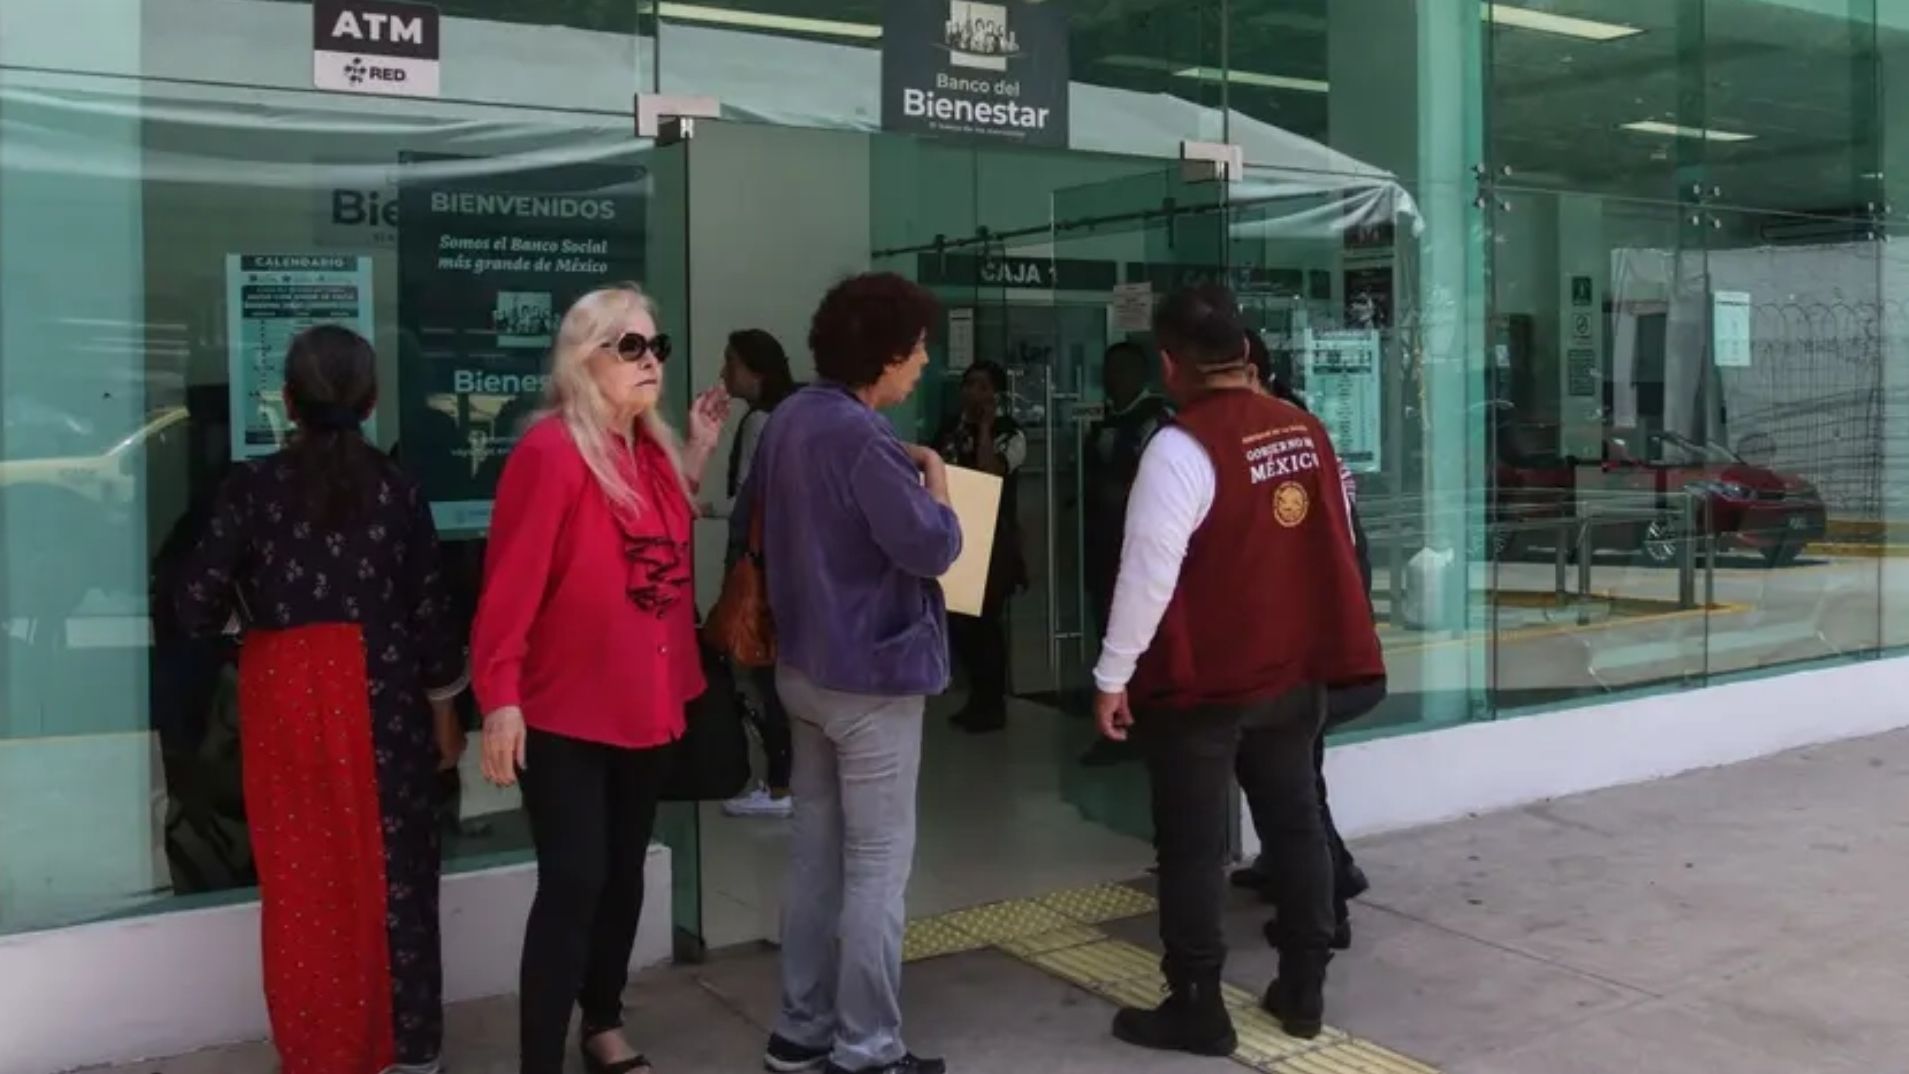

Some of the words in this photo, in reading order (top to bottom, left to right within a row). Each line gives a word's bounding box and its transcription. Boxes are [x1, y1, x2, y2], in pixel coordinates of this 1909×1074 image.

[331, 10, 423, 44] ATM
[368, 66, 406, 82] RED
[936, 73, 990, 93] Banco
[993, 81, 1020, 97] del
[903, 88, 1050, 128] Bienestar
[431, 192, 615, 219] BIENVENIDOS
[439, 234, 491, 250] Somos
[493, 236, 507, 250] el
[511, 236, 560, 253] Banco
[562, 239, 608, 254] Social
[254, 256, 344, 268] CALENDARIO
[438, 253, 473, 271] más
[474, 257, 531, 274] grande
[533, 259, 552, 271] de
[555, 255, 608, 274] México
[980, 262, 1041, 284] CAJA
